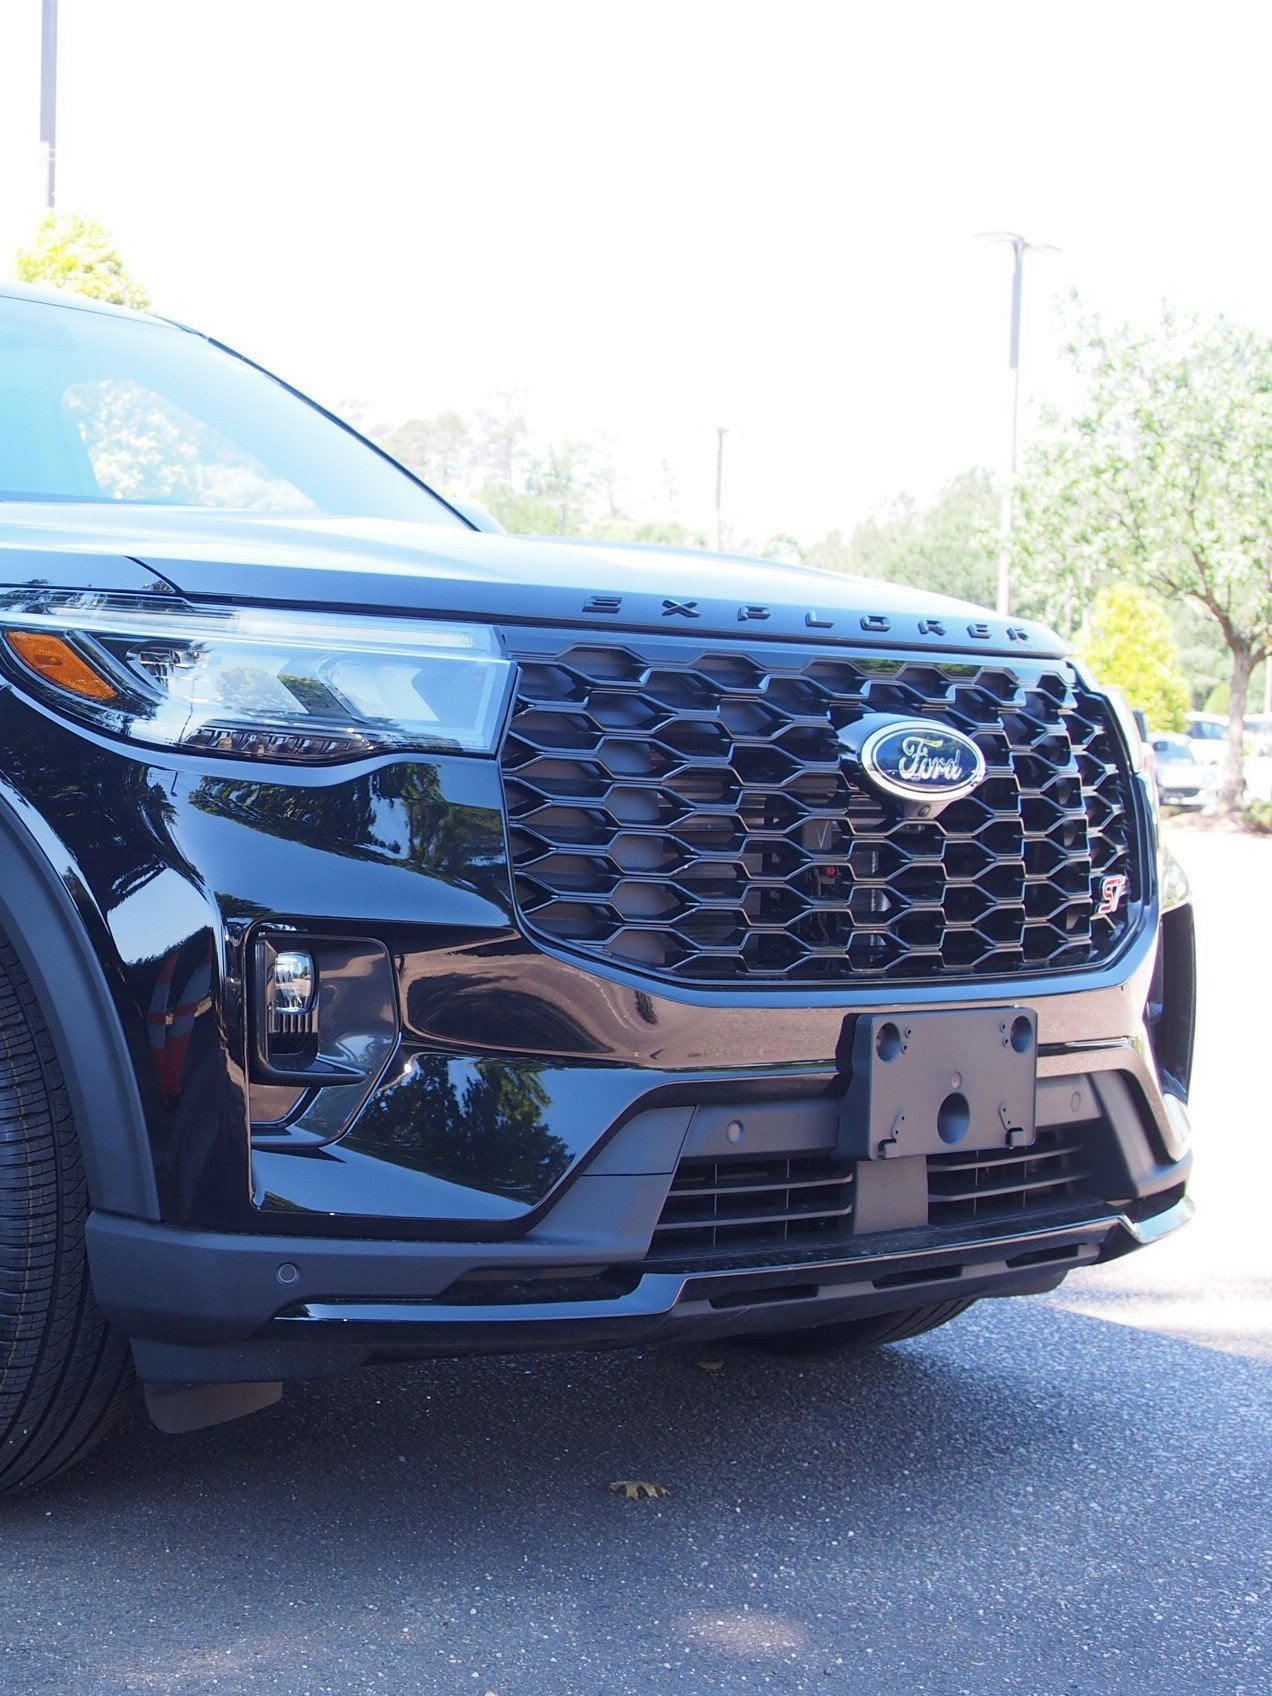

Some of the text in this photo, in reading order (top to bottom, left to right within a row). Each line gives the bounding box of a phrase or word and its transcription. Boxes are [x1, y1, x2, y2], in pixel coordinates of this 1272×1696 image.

[582, 595, 1031, 643] EXPLORER
[898, 736, 963, 781] Ford
[1098, 876, 1126, 913] ST
